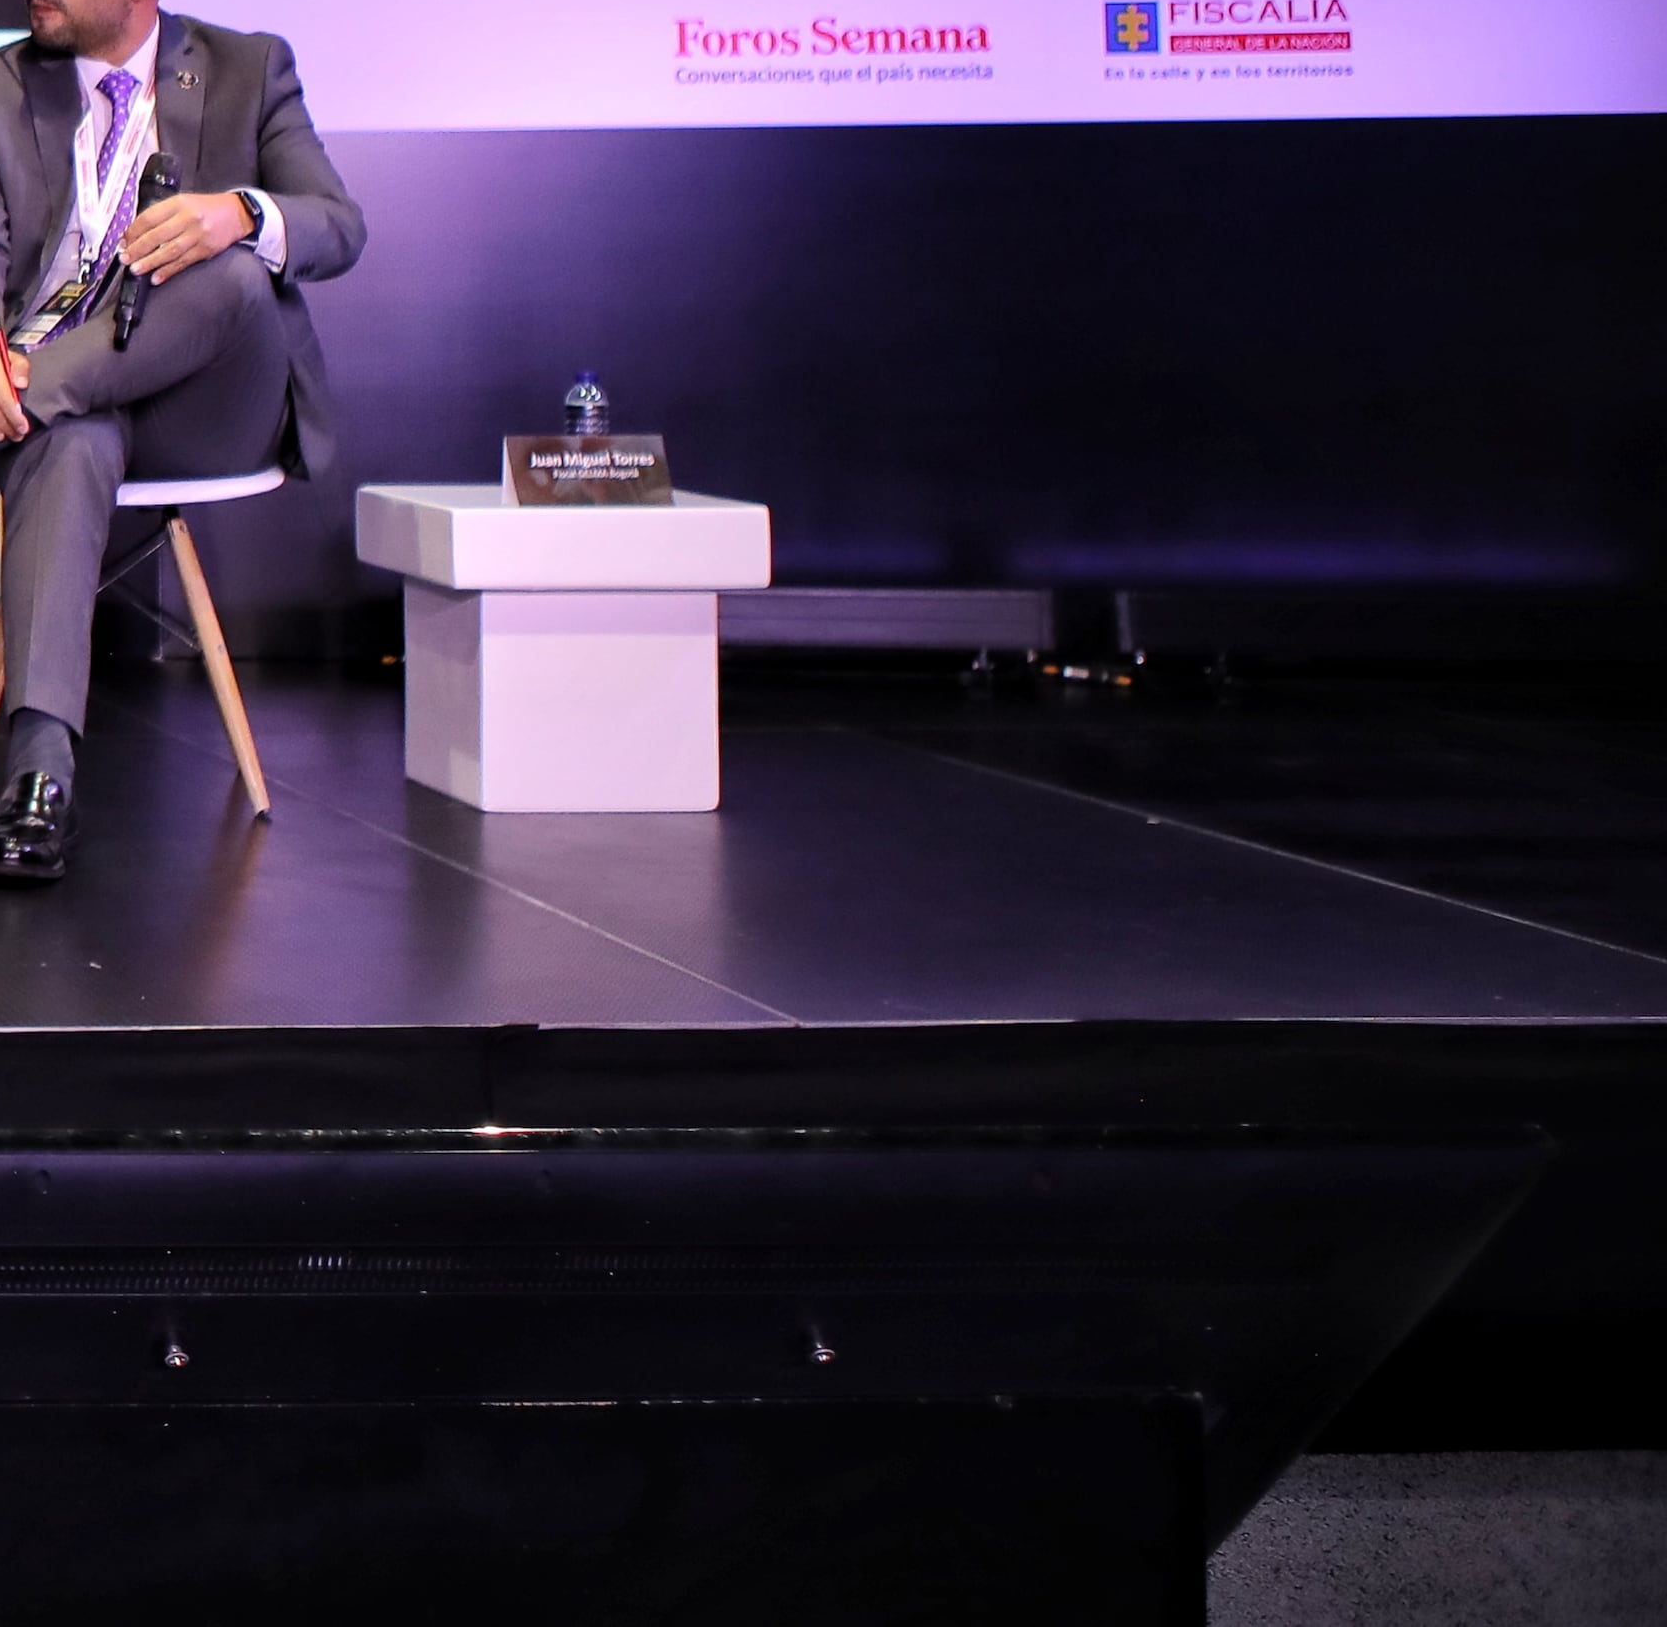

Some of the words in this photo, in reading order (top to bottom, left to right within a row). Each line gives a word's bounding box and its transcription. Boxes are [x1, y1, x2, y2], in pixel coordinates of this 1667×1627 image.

[674, 19, 800, 58] Foros
[810, 16, 992, 56] Semana
[1175, 37, 1244, 53] GENERAL
[1245, 36, 1265, 51] DE
[1269, 36, 1288, 50] LA
[1289, 33, 1348, 50] NACIÓN
[675, 66, 815, 84] Conversaciones
[819, 68, 852, 86] que
[856, 65, 872, 82] el
[877, 63, 914, 85] país
[918, 63, 994, 82] necesita
[1235, 65, 1262, 78] los
[1267, 64, 1354, 78] territorios
[530, 451, 562, 468] Juan
[563, 451, 611, 468] Miguel
[612, 452, 655, 467] Torres
